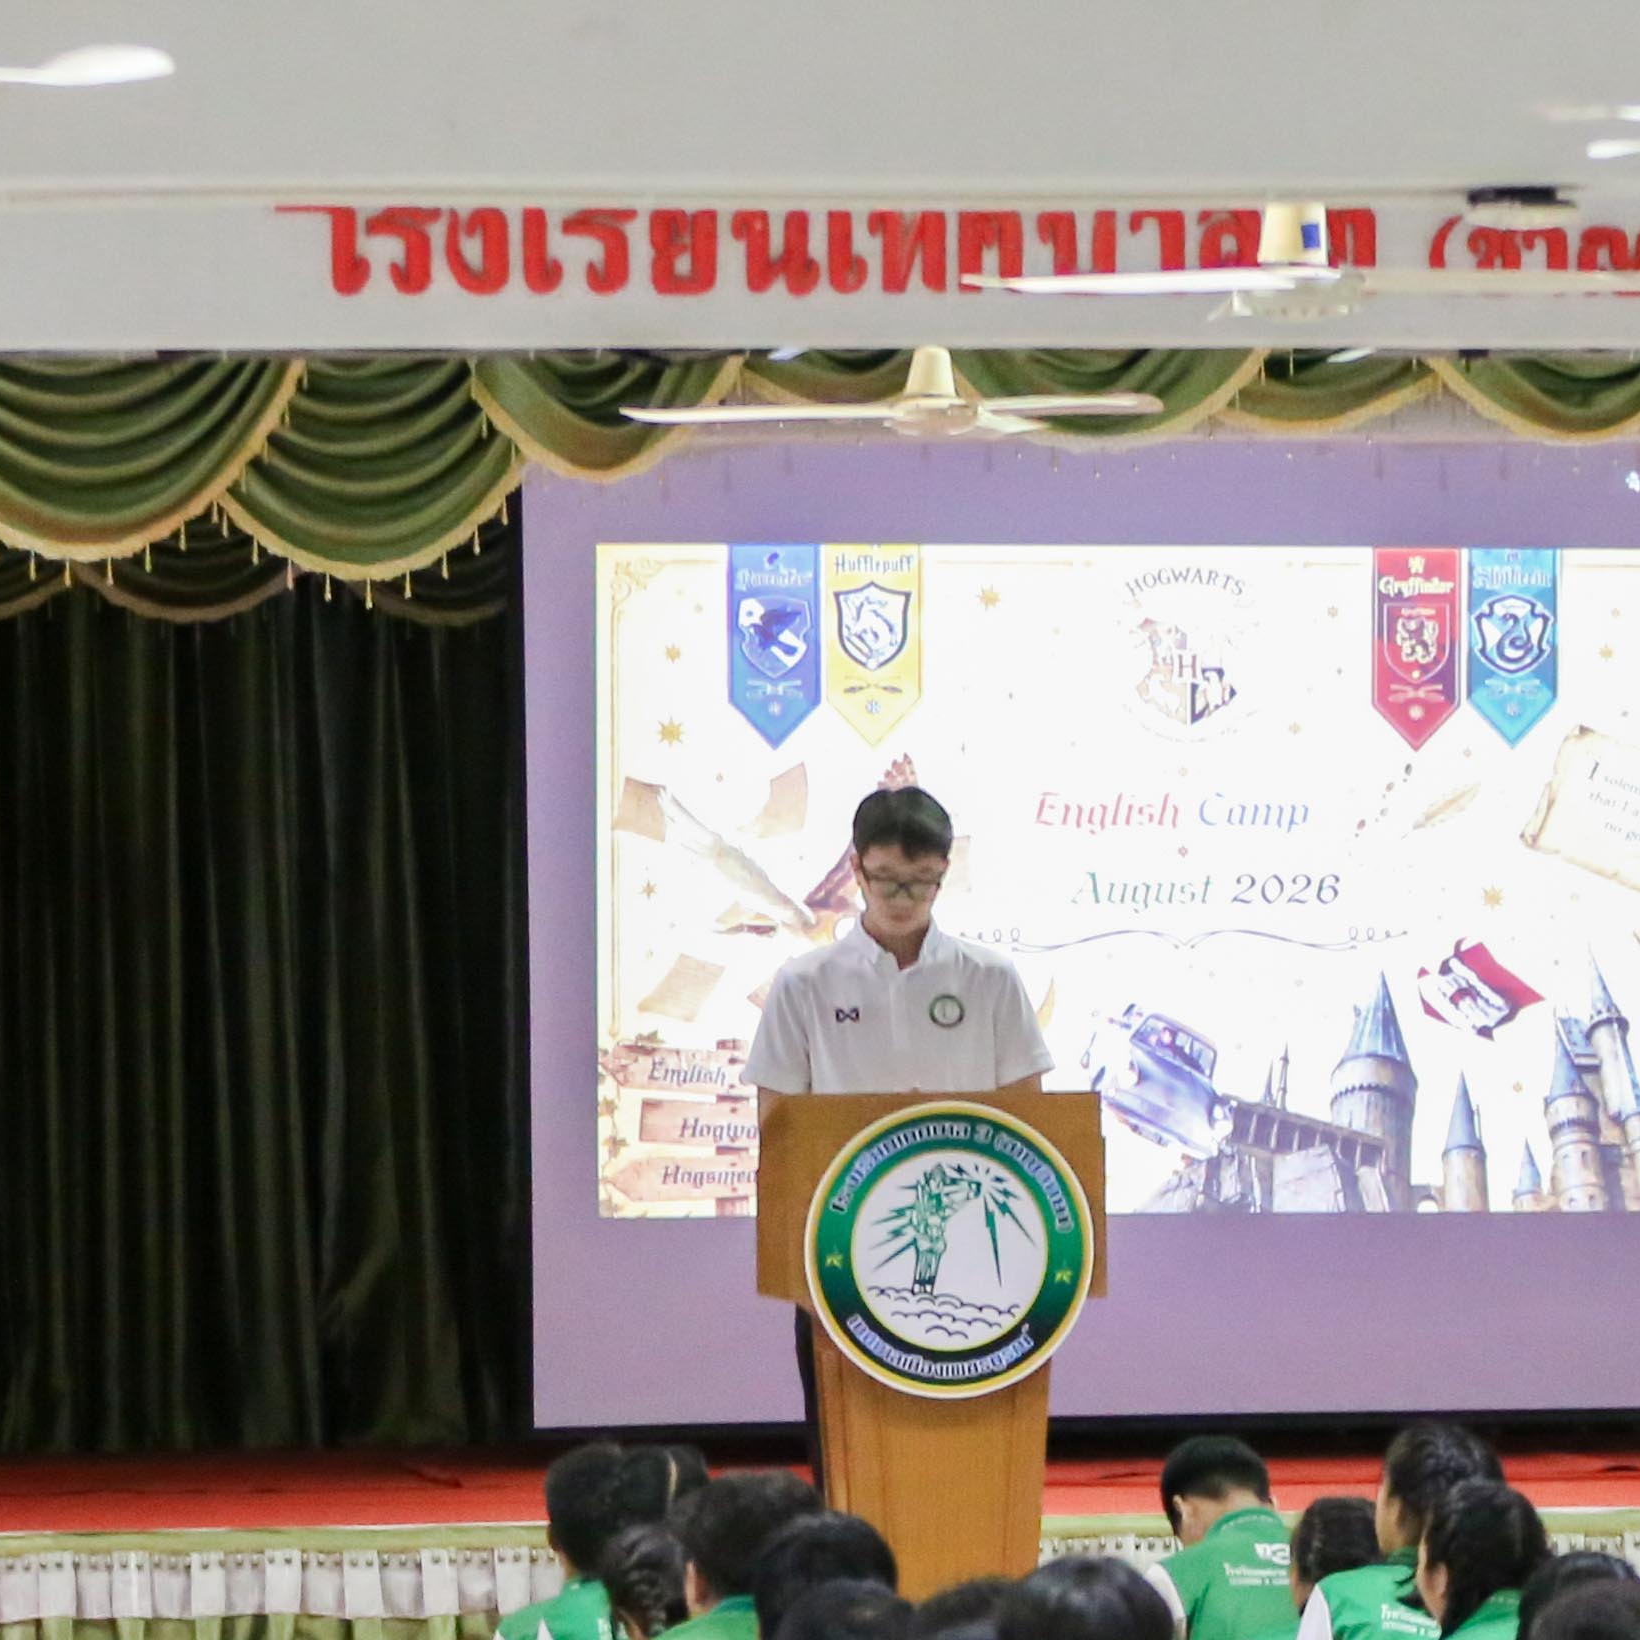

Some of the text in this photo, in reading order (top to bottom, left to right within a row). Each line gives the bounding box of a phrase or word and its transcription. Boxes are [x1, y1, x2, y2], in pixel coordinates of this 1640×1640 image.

[834, 553, 913, 575] Hufflepuff
[1125, 567, 1246, 597] HOGWARTS
[1035, 792, 1310, 835] English Camp
[1070, 871, 1341, 914] August 2026
